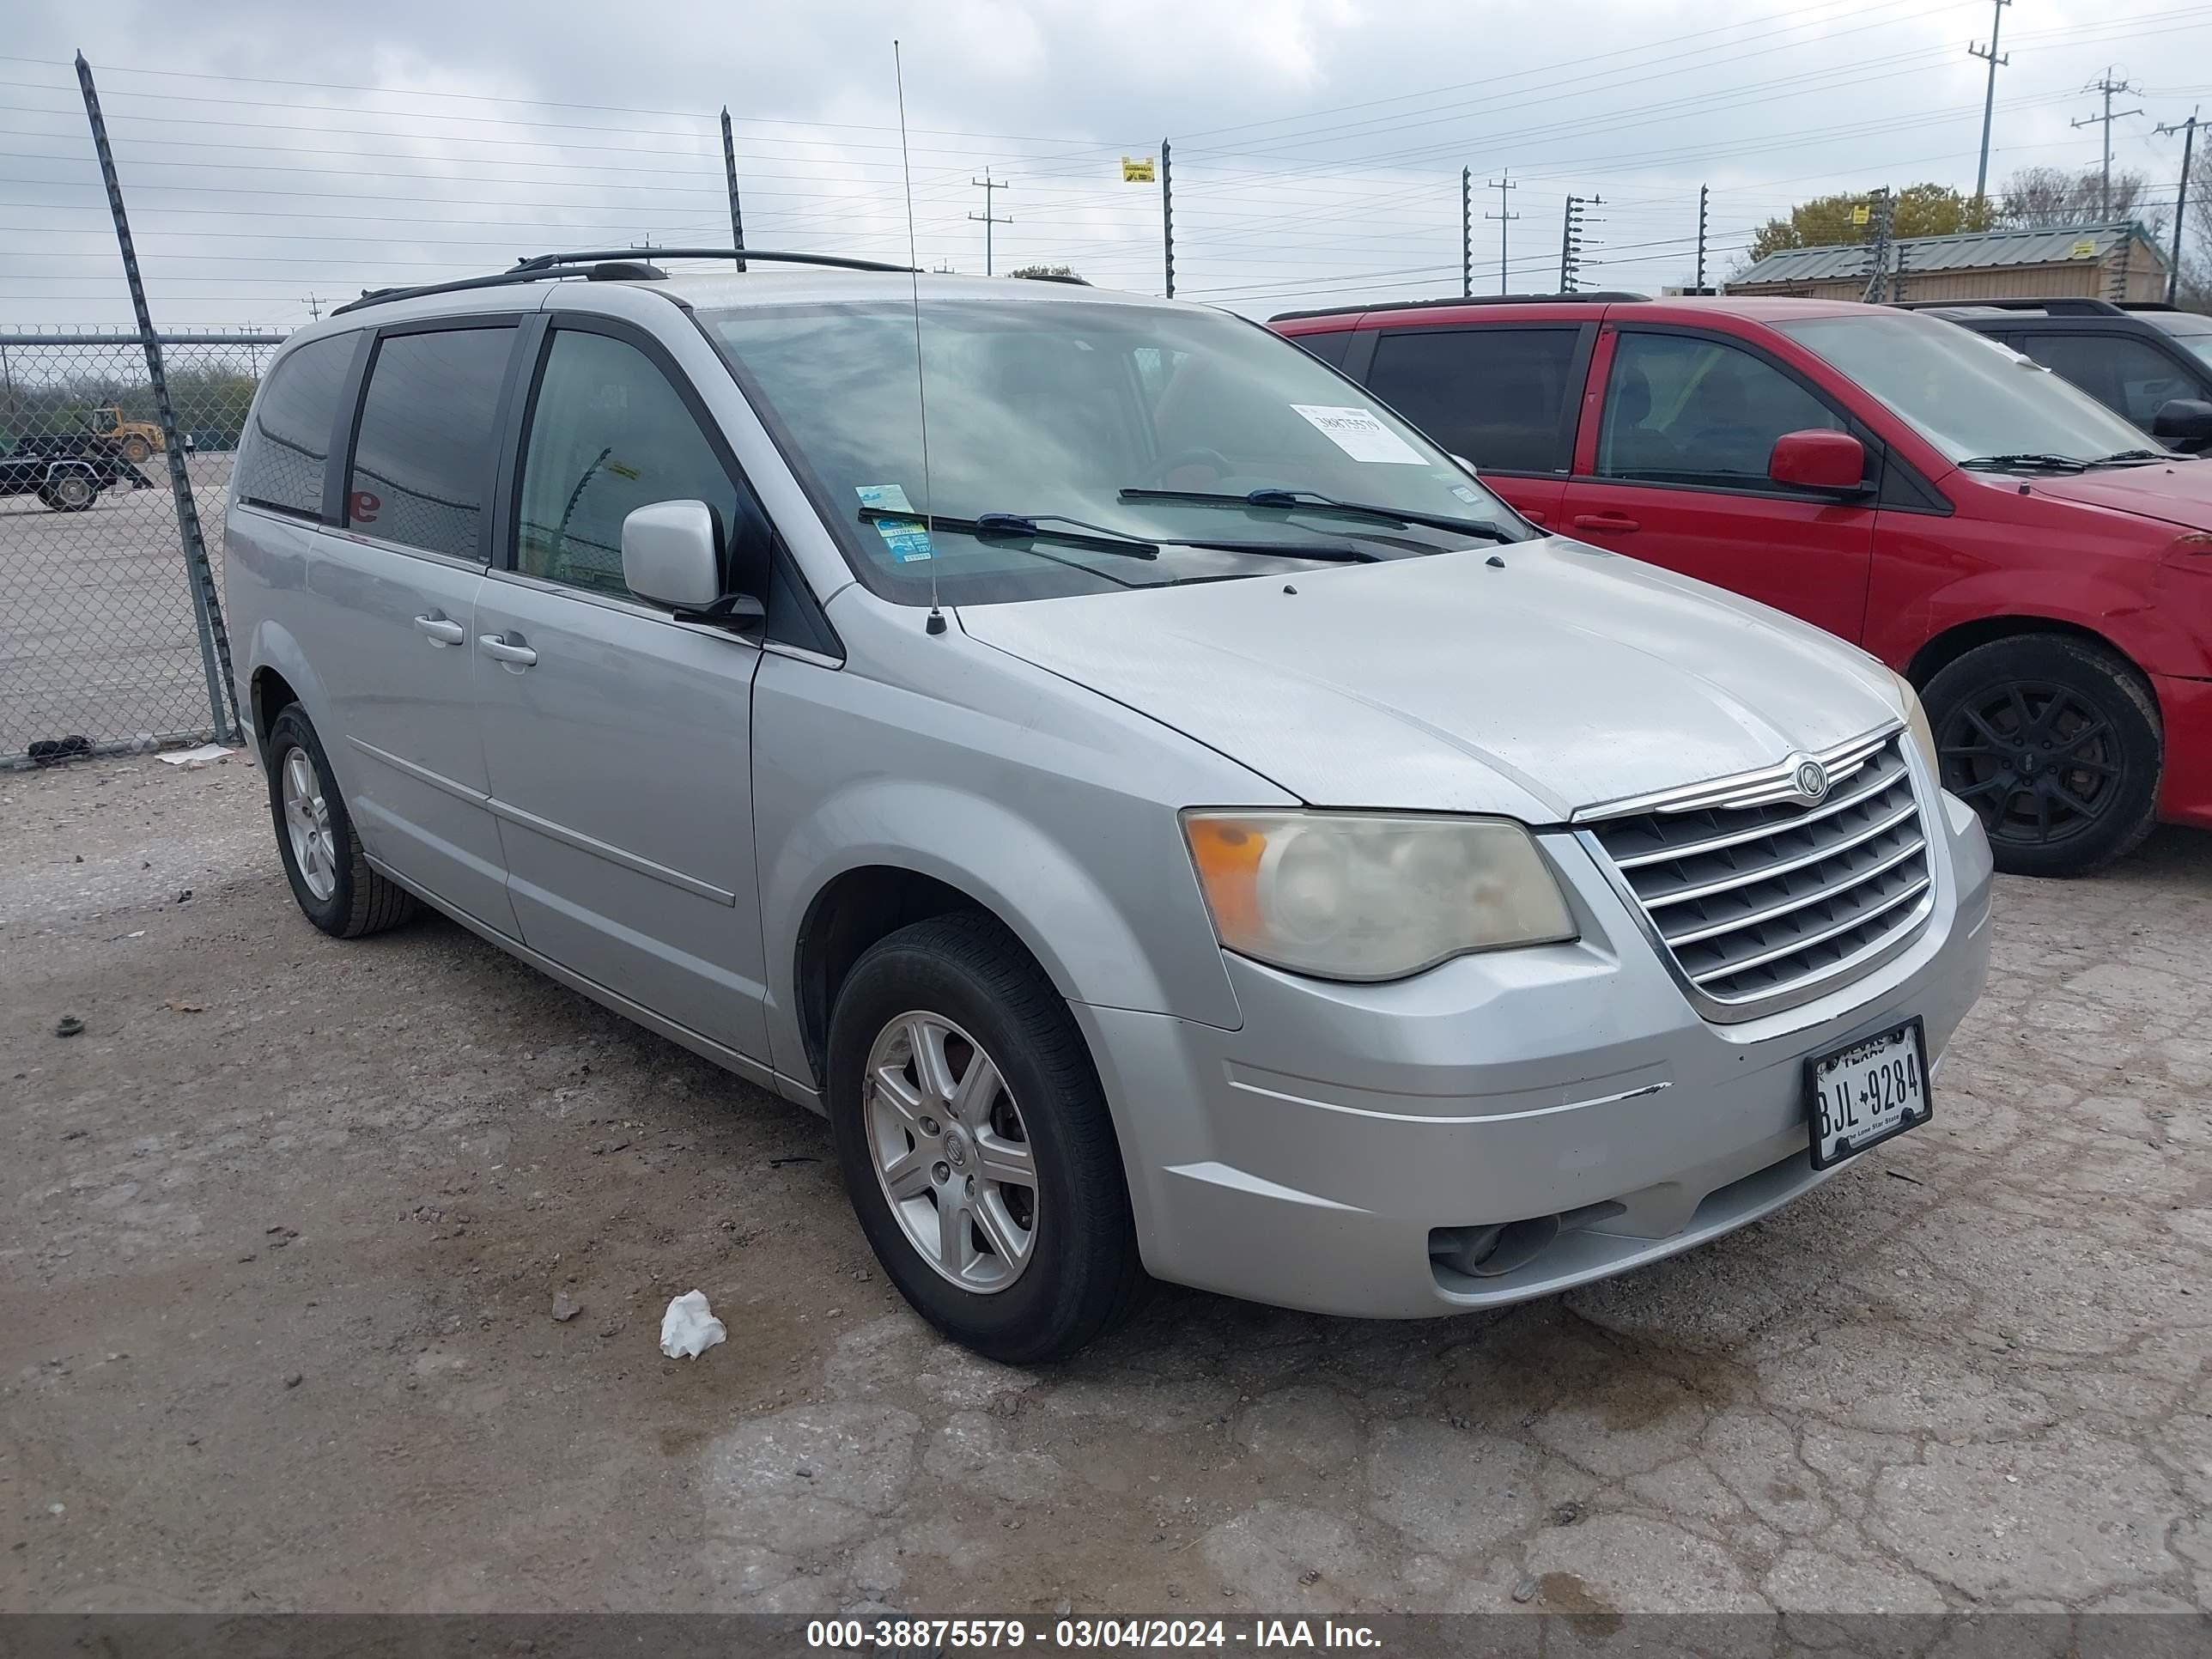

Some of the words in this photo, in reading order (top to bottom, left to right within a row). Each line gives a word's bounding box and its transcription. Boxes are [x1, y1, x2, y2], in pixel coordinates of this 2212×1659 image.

[1315, 416, 1380, 431] 38875579
[1868, 1053, 1917, 1115] 9284
[1857, 1127, 1871, 1136] Lone
[1872, 1121, 1883, 1130] Star
[1885, 1115, 1899, 1124] State
